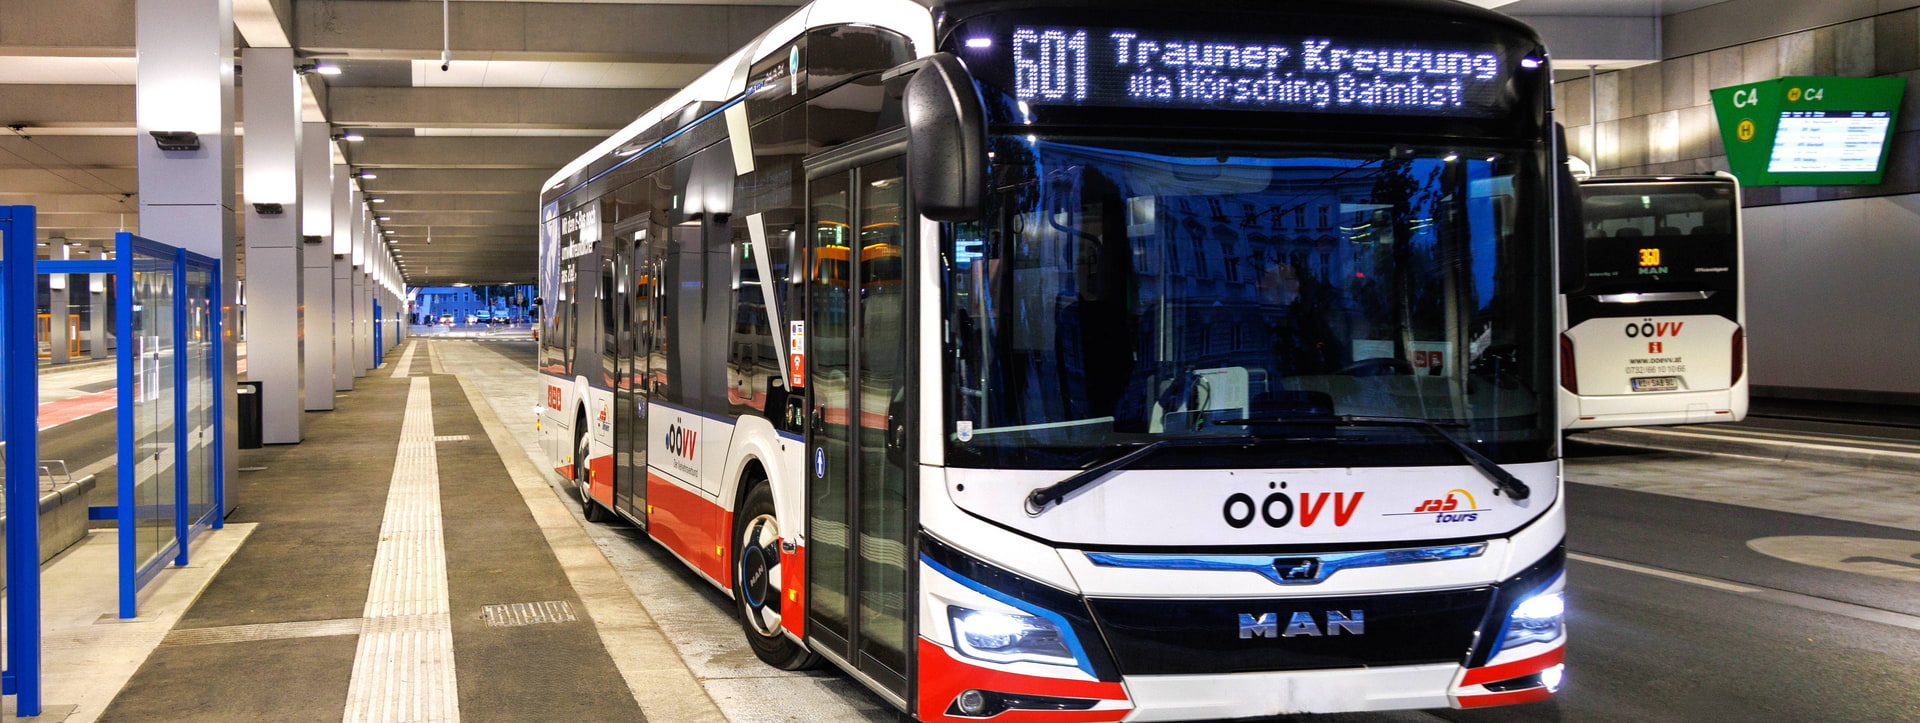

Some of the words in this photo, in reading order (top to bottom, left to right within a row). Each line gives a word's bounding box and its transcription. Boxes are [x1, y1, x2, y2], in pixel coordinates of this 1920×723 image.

[1013, 29, 1087, 99] 601
[1110, 32, 1288, 69] Trauner
[1304, 39, 1497, 80] Kreuzung
[1130, 68, 1171, 97] via
[1179, 68, 1330, 107] Hörsching
[1733, 88, 1758, 108] C4
[1804, 88, 1824, 101] C4
[1638, 266, 1669, 275] MAN
[1625, 318, 1684, 338] OÖVV
[669, 416, 697, 461] OÖVV
[1223, 481, 1365, 529] OÖVV
[1414, 494, 1458, 512] sab
[1436, 512, 1478, 523] tours
[750, 564, 764, 587] MAN
[1238, 610, 1365, 638] MAN
